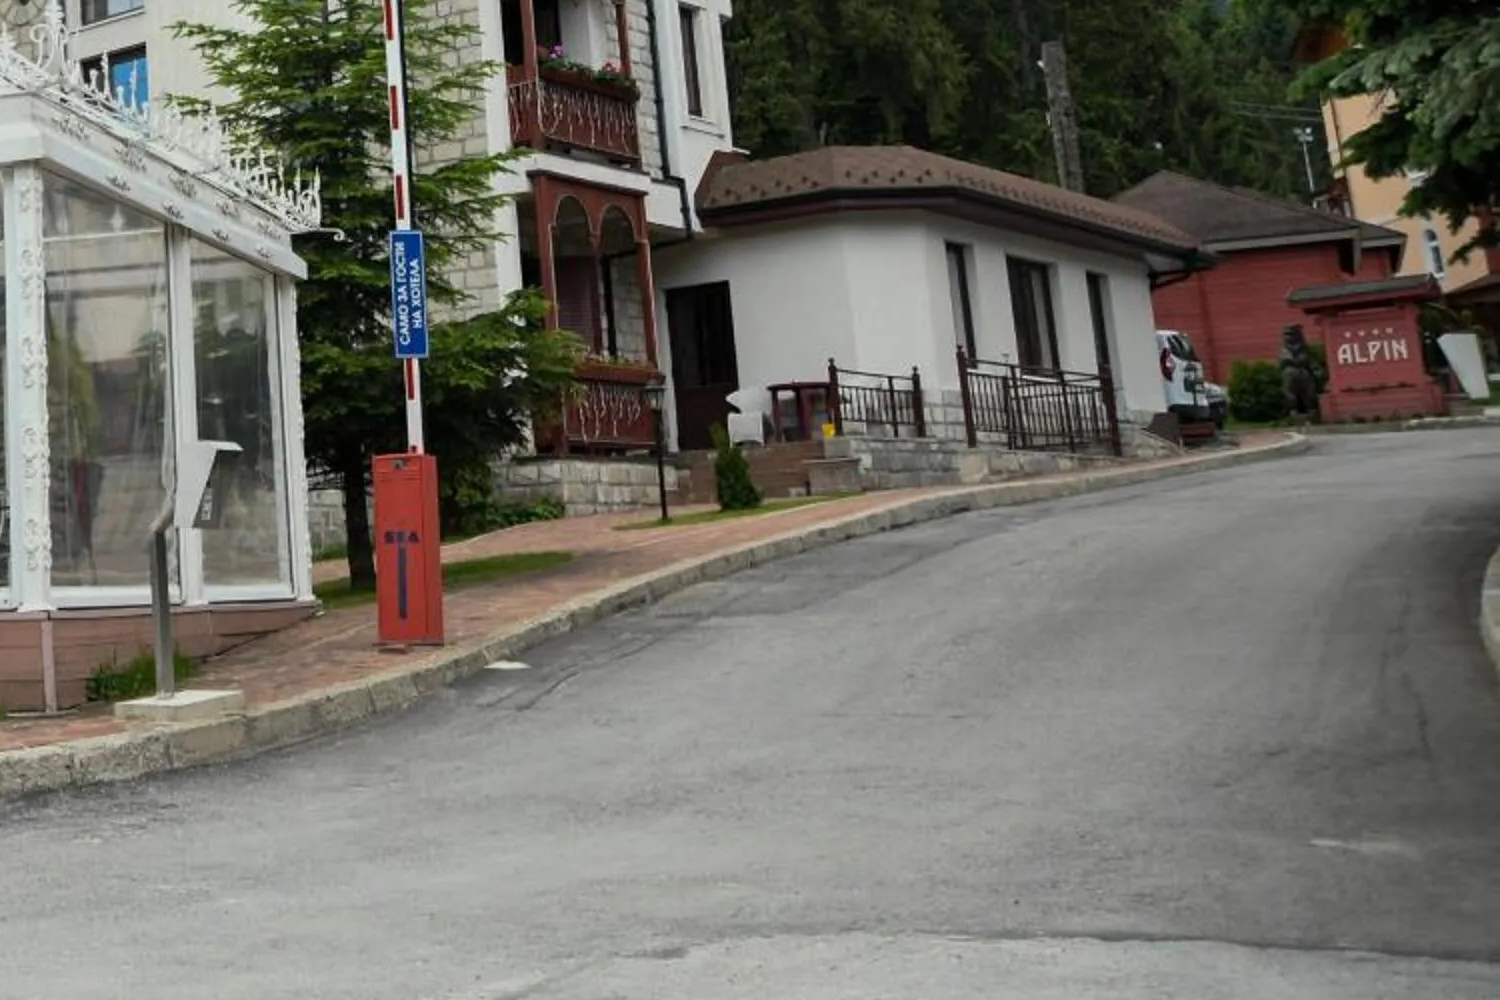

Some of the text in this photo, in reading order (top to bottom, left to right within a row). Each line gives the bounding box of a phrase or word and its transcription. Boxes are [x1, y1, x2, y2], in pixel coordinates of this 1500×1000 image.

[394, 240, 411, 346] САМО ЗА ГОСТИ
[409, 258, 423, 329] НА ХОТЕЛА
[1337, 339, 1409, 366] ALPIN
